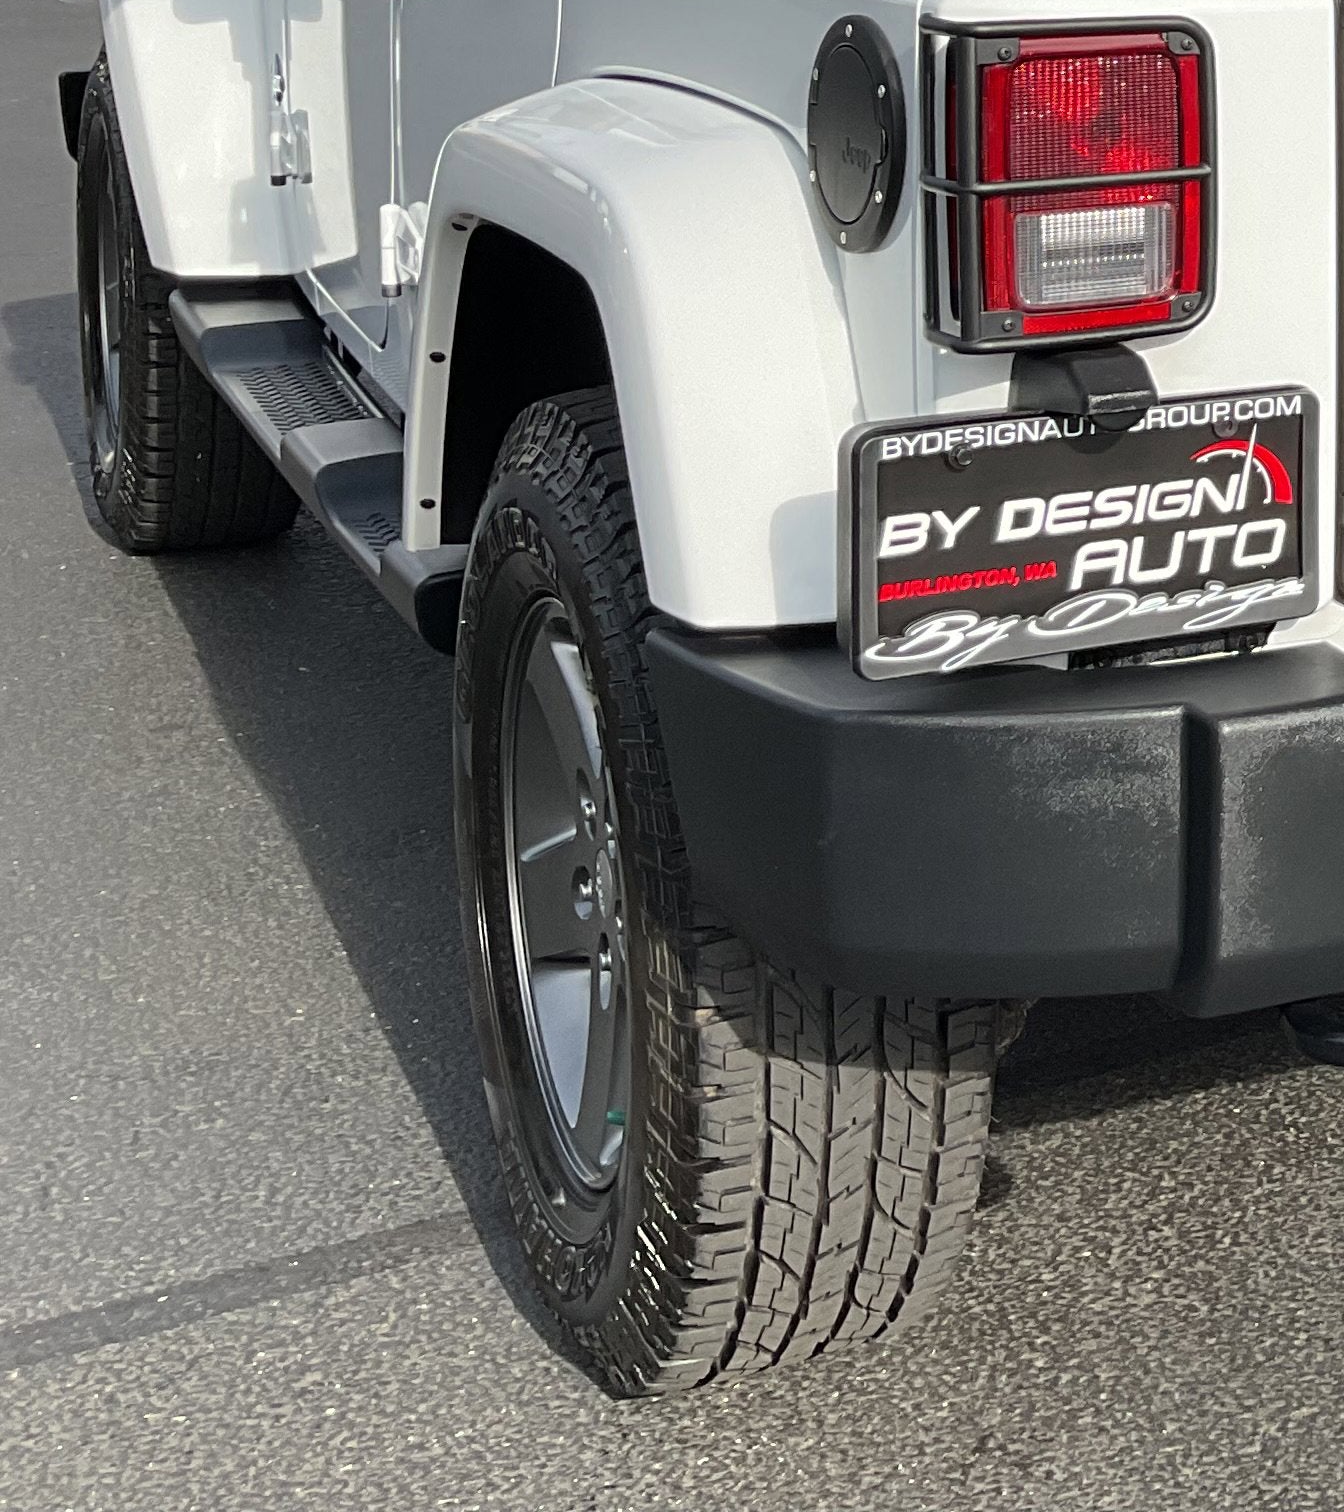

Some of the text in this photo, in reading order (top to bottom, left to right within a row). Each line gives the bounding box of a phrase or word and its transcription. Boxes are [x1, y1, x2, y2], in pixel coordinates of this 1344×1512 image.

[842, 136, 872, 175] Jeep
[881, 395, 1303, 461] BYDESIGNAUROUP.COM
[877, 472, 1250, 559] BY DESIGN
[878, 560, 1057, 603] BURLINGTON, WA
[1067, 517, 1287, 591] AUTO
[863, 576, 1306, 673] By Design
